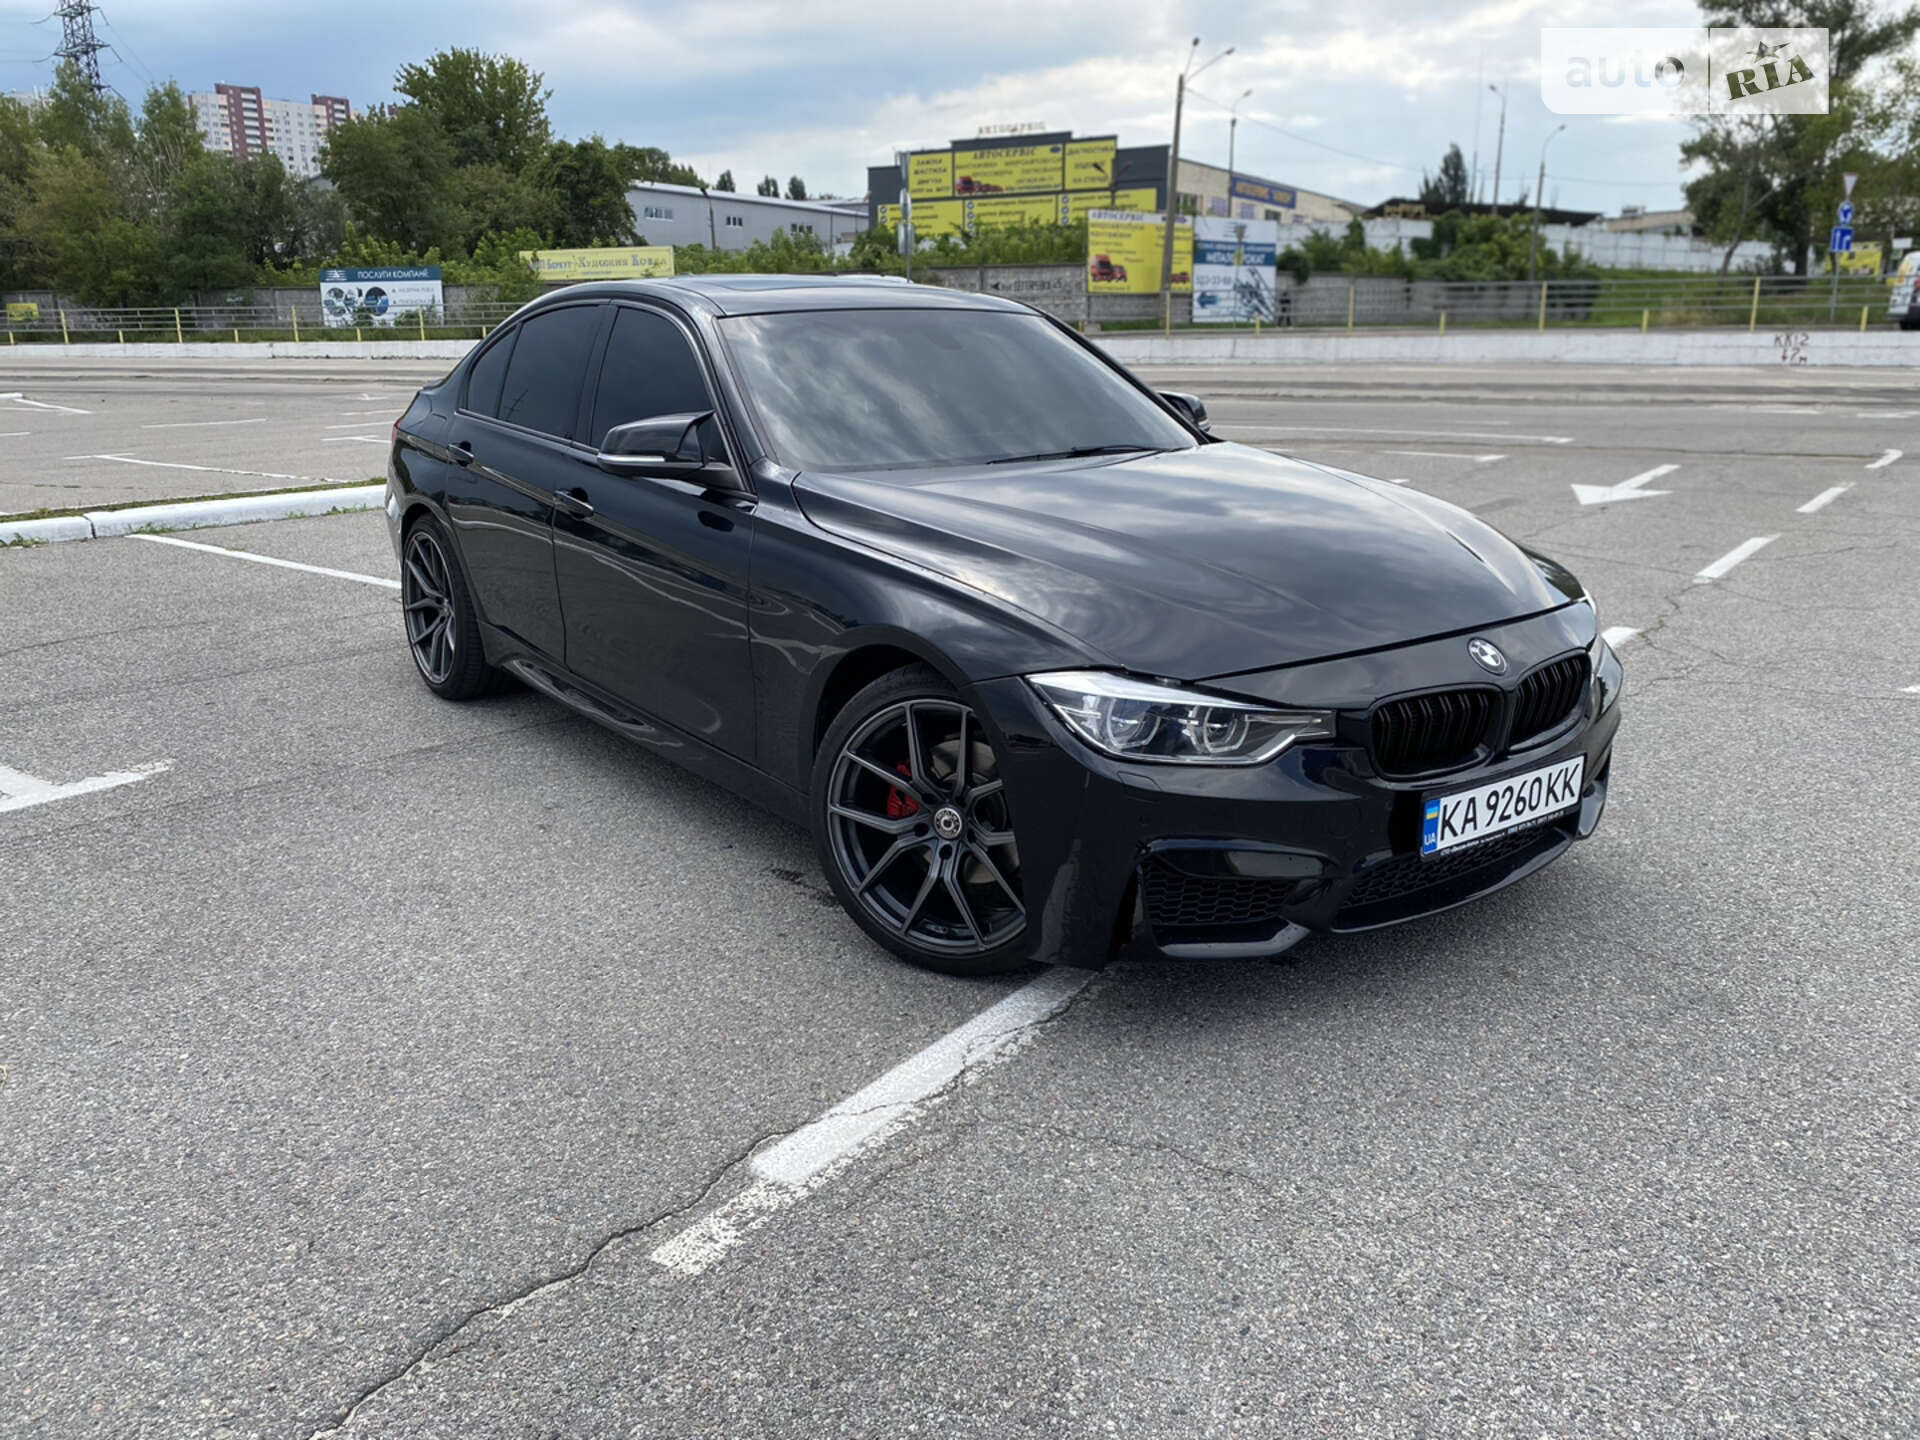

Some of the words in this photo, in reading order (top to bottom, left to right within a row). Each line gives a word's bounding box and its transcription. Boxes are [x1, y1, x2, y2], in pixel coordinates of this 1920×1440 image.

[973, 147, 1037, 160] АВТОСЕРВІС
[1092, 211, 1144, 220] АВТОСЕРВІС
[1206, 252, 1265, 265] МЕТАЛОКАТ
[357, 271, 392, 280] ПОСЛУГИ
[1440, 796, 1478, 842] KA
[1485, 776, 1542, 828] 9260
[1545, 763, 1580, 808] KK
[1424, 832, 1437, 846] UA
